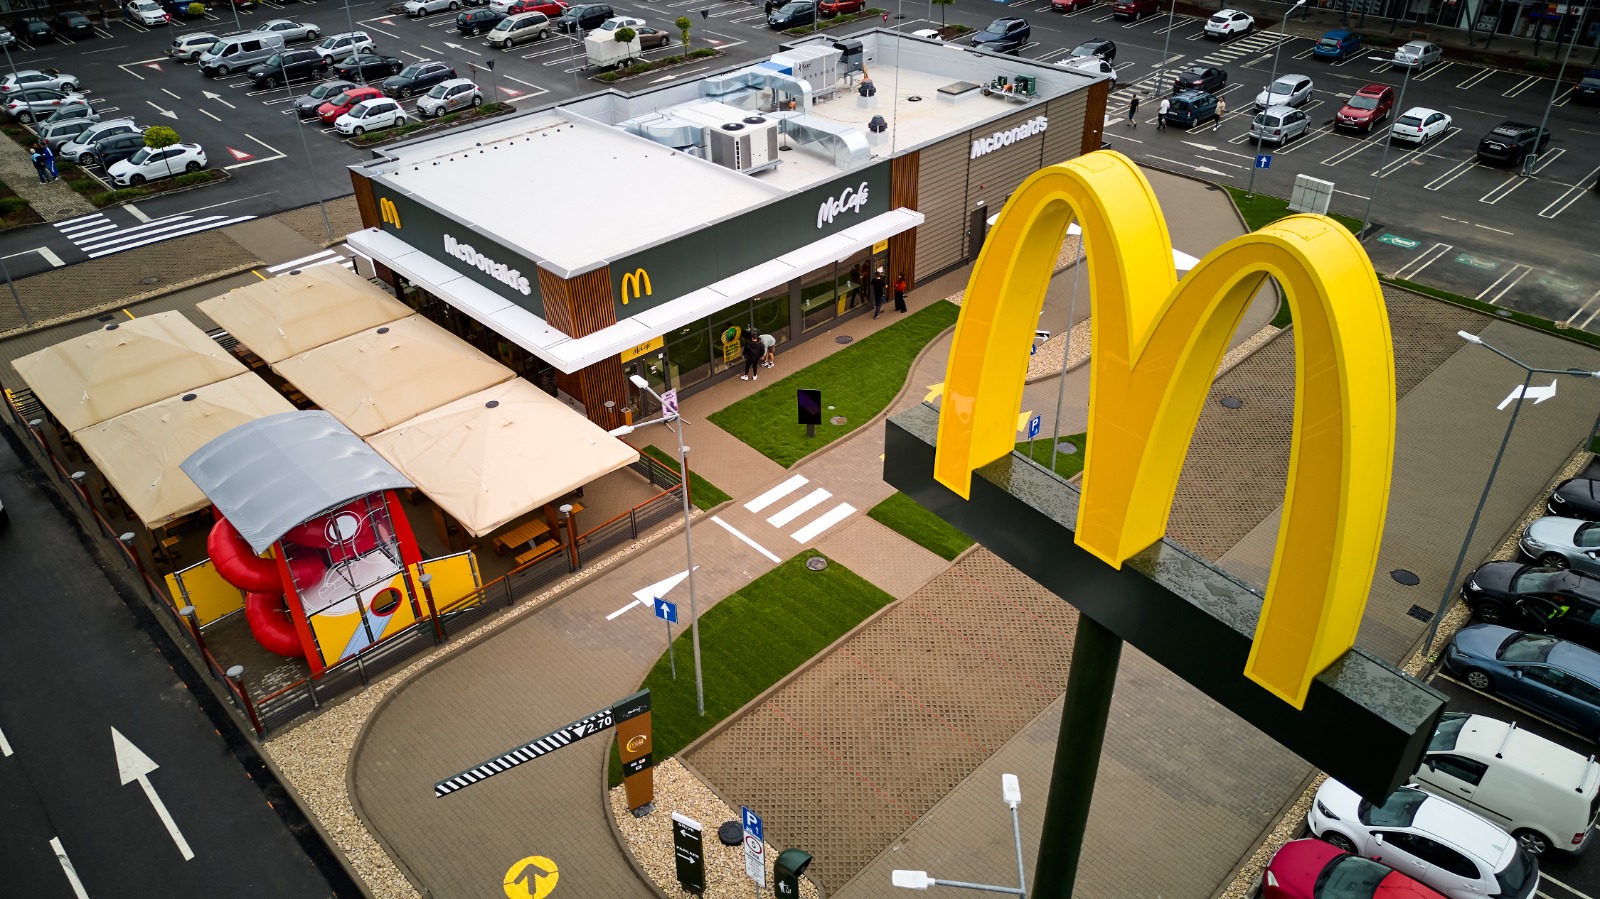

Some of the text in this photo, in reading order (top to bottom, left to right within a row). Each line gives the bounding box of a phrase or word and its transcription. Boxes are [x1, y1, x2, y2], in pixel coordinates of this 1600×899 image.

[970, 116, 1048, 160] McDonald's
[817, 181, 869, 229] McCafé
[444, 234, 531, 295] McDonald's
[1032, 419, 1038, 431] P
[586, 716, 612, 734] 2.70
[746, 811, 758, 826] P
